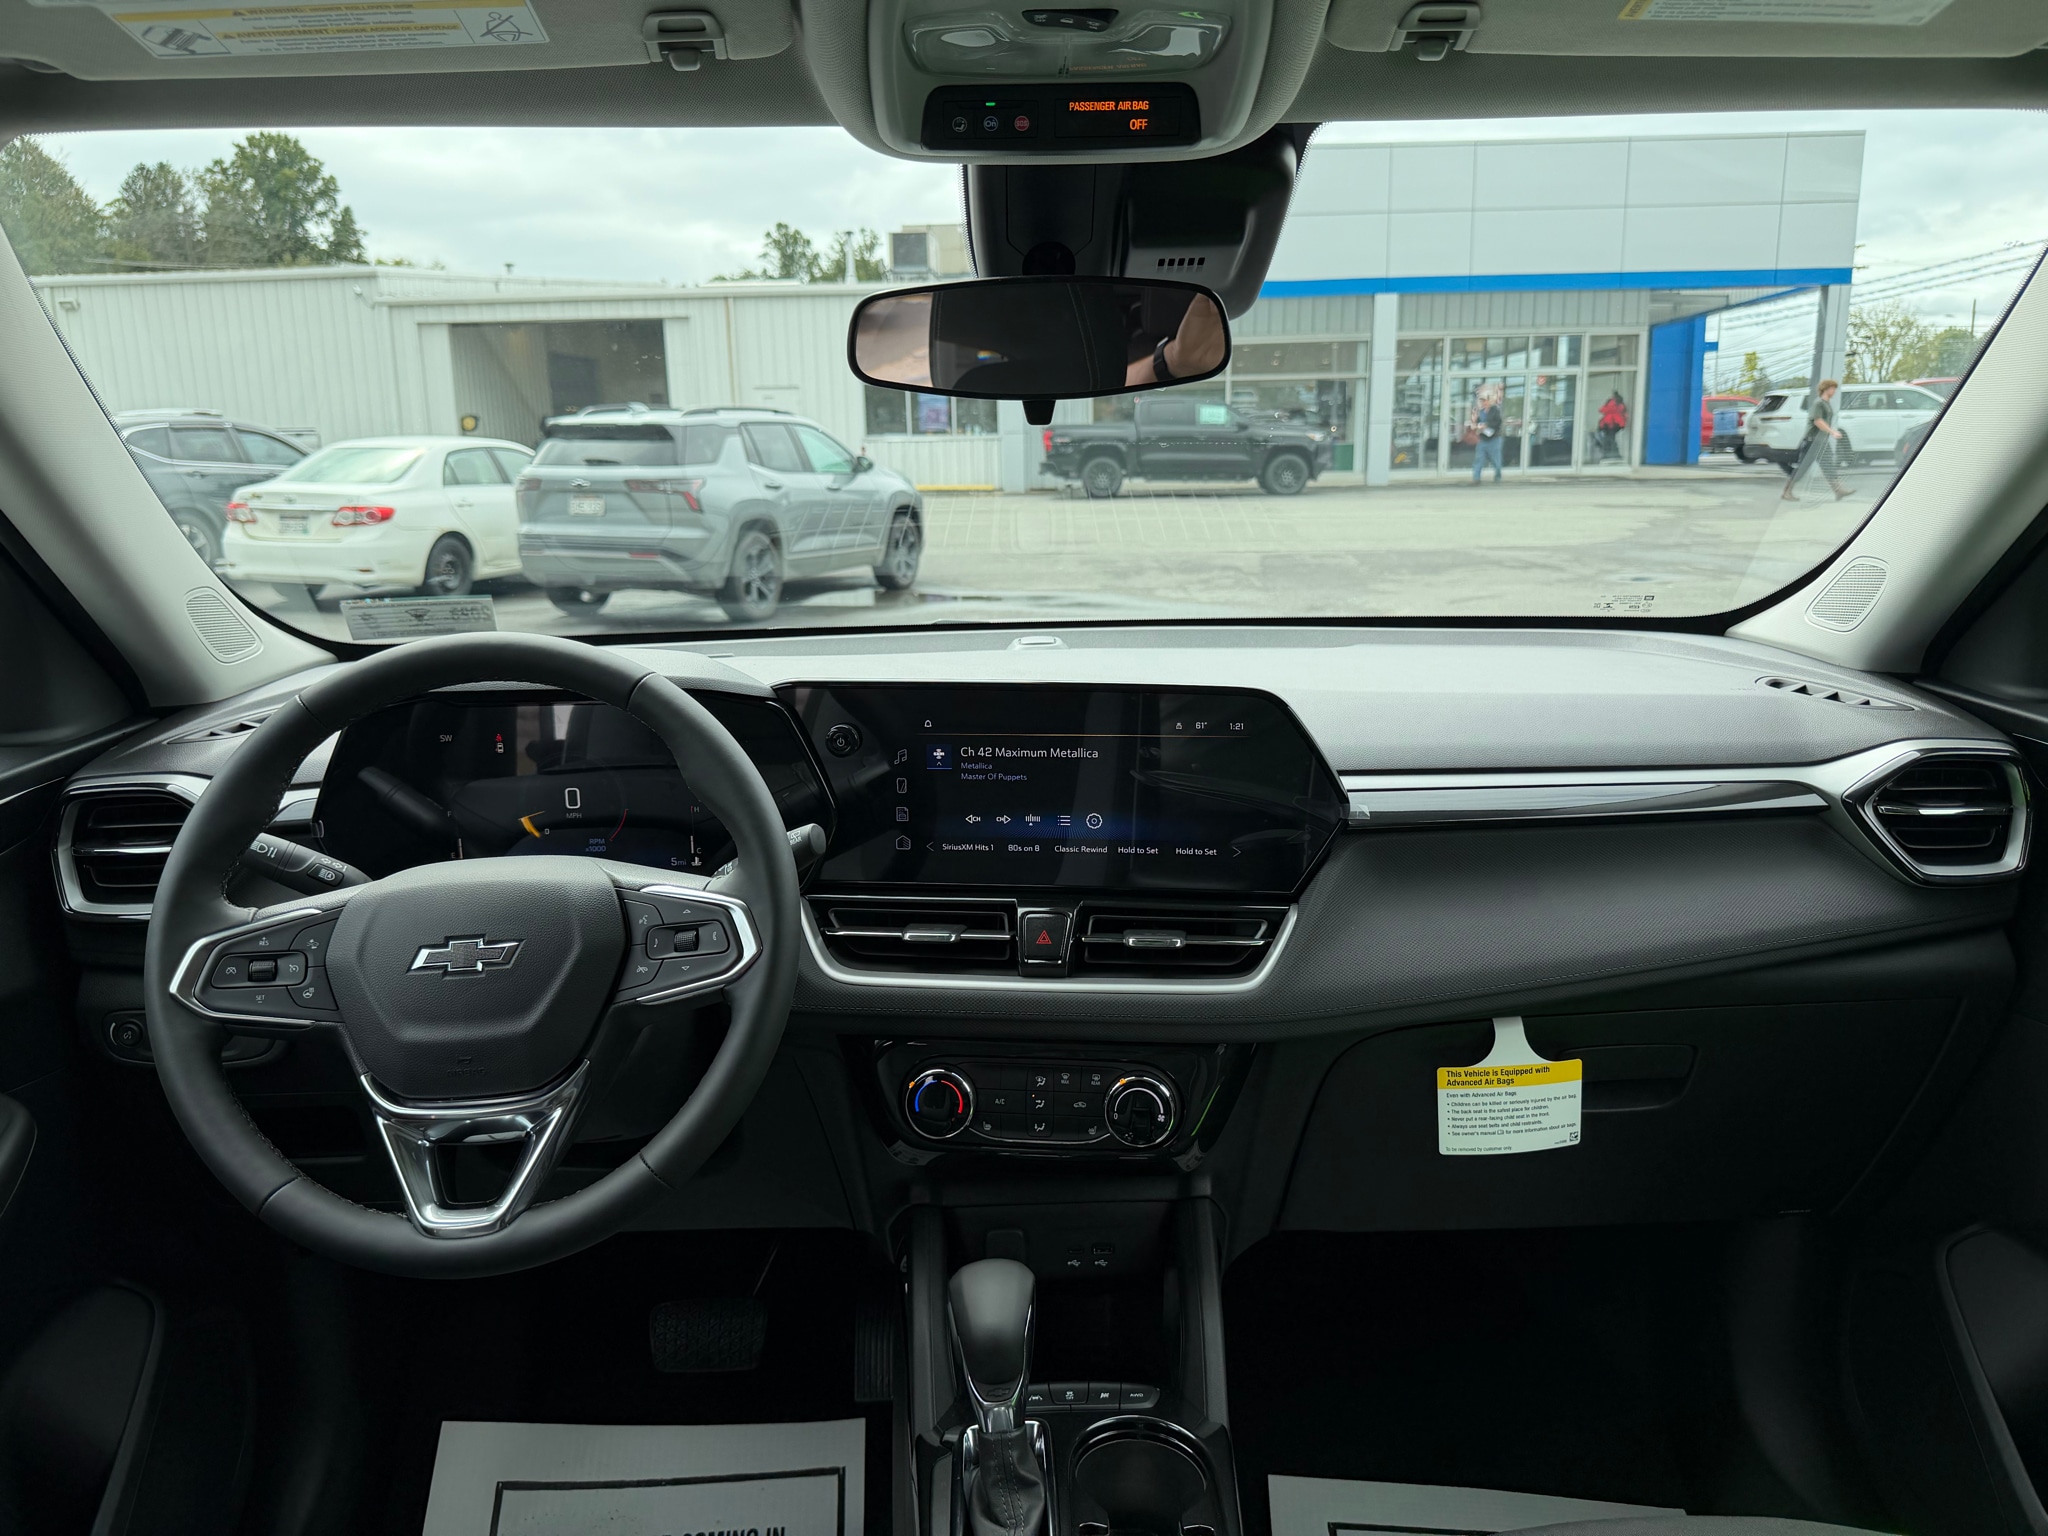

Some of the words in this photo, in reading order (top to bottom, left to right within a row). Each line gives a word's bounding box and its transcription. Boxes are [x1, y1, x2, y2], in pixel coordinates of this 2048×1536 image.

[1069, 102, 1115, 111] PASSENGER
[1117, 101, 1131, 110] AIR
[1132, 101, 1149, 110] BAG
[1129, 119, 1148, 130] OFF
[1230, 722, 1244, 730] 1:21
[440, 734, 453, 743] SW
[960, 747, 975, 757] Ch
[977, 747, 992, 757] 42
[995, 748, 1047, 758] Maximum
[1050, 748, 1099, 758] Metallica
[960, 762, 993, 770] Metallica
[998, 773, 1028, 782] Puppets
[564, 787, 581, 809] 0
[790, 837, 802, 846] REAR
[942, 843, 974, 851] SiriusXM
[1008, 844, 1022, 852] 80s
[1054, 845, 1079, 853] Classic
[1118, 846, 1135, 854] Hold
[1204, 848, 1217, 856] Set
[1446, 1070, 1462, 1078] This
[1464, 1069, 1490, 1077] Vehicle
[1500, 1067, 1533, 1077] Equipped
[1535, 1066, 1550, 1074] with
[1446, 1078, 1482, 1086] Advanced
[1484, 1077, 1494, 1085] Air
[1497, 1077, 1515, 1086] Bags
